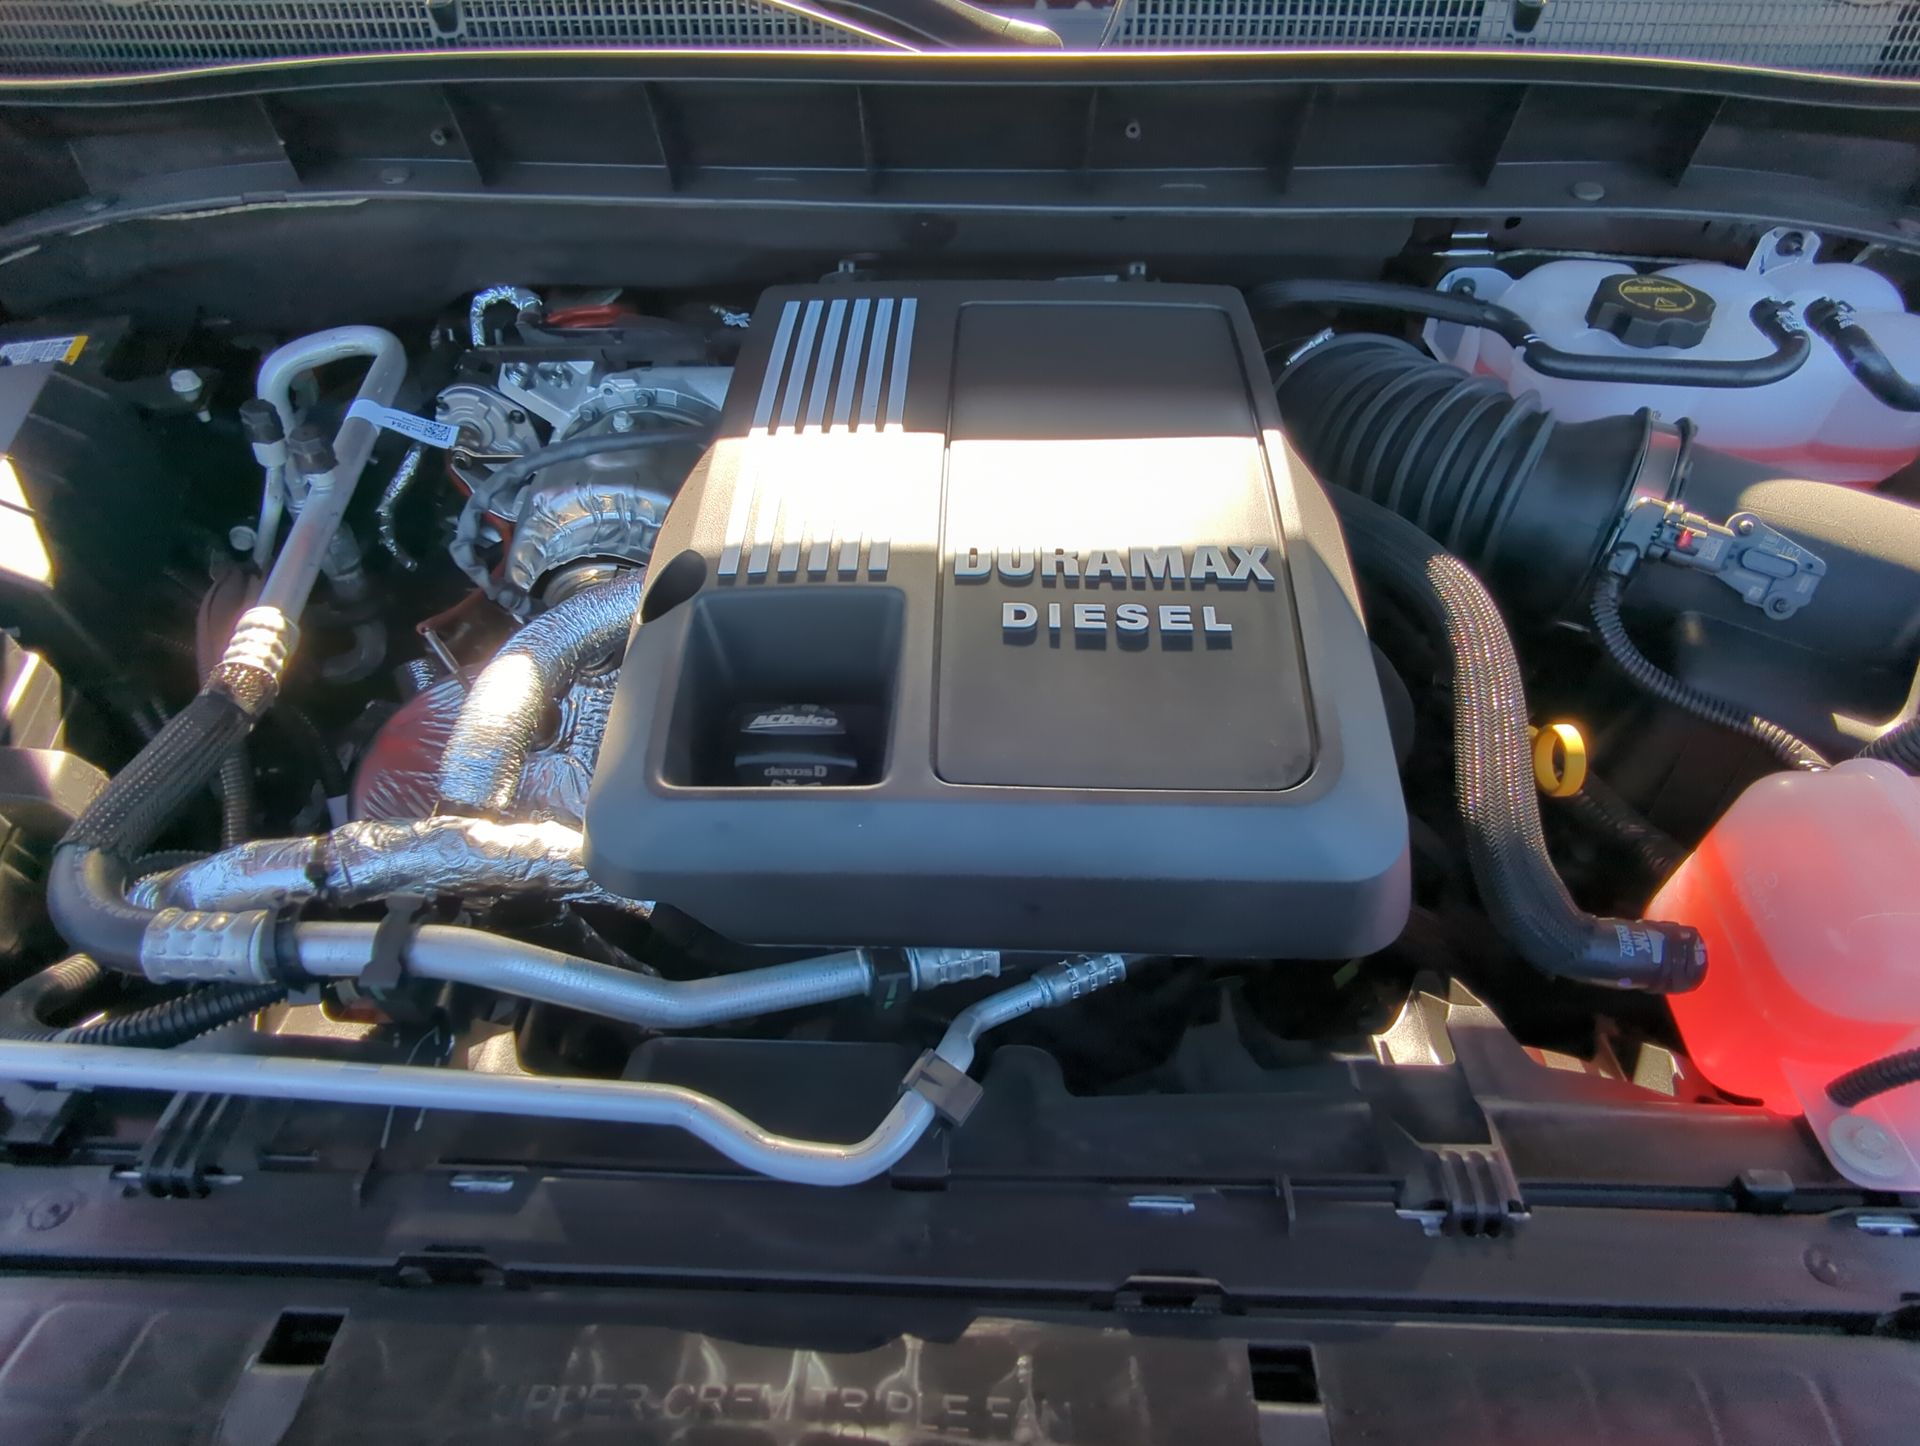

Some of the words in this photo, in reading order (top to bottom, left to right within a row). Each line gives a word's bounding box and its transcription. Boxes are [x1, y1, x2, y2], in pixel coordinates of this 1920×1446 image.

[954, 546, 1275, 582] DURAMAX
[1002, 602, 1232, 632] DIESEL
[749, 715, 838, 729] ACDelco
